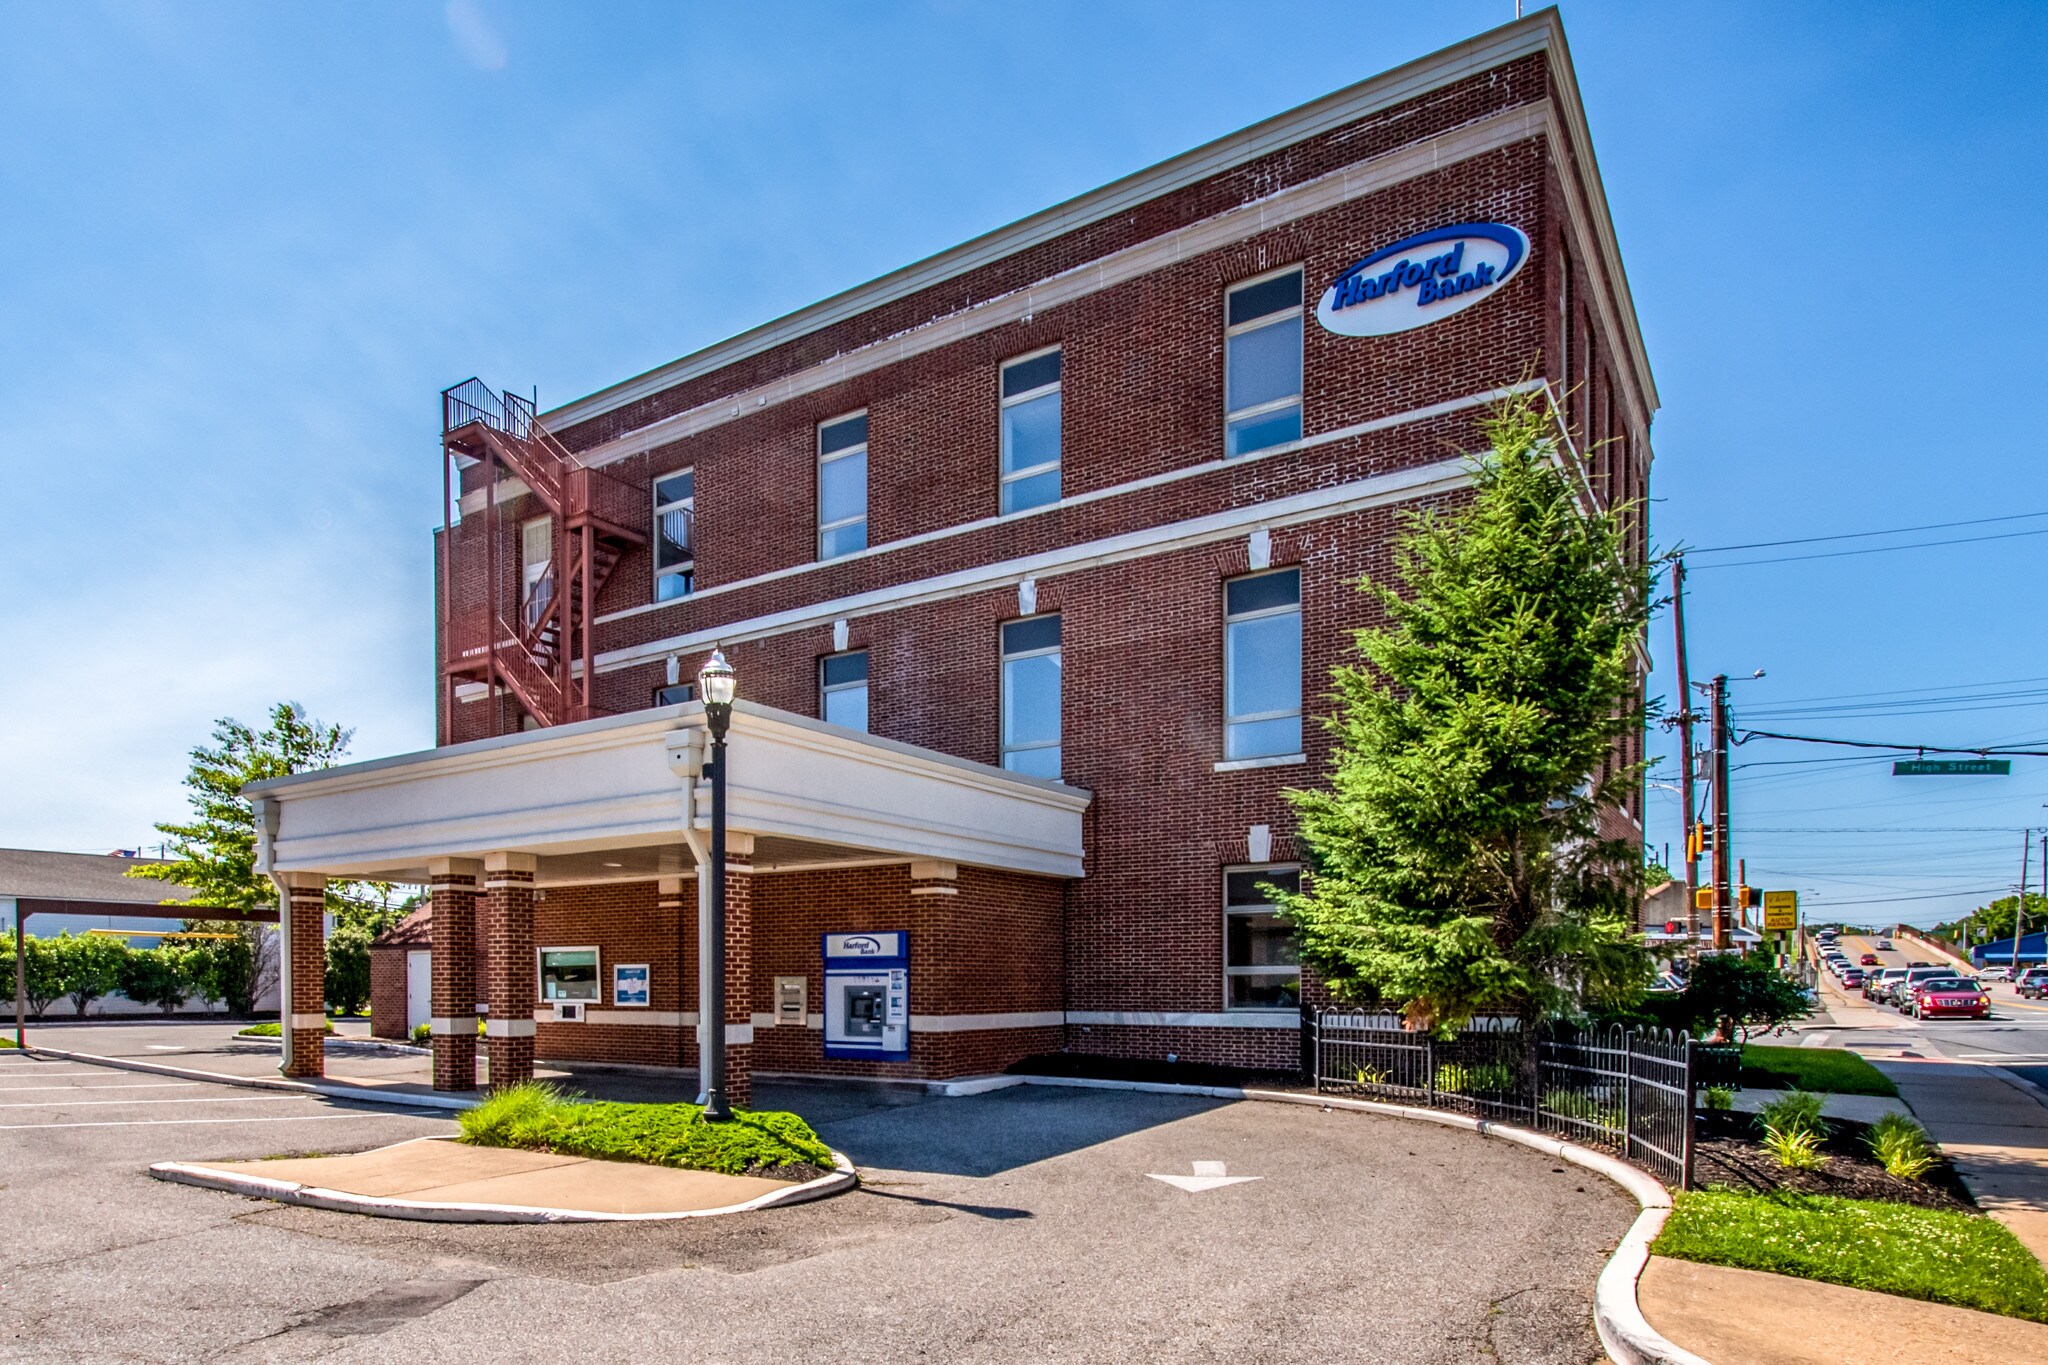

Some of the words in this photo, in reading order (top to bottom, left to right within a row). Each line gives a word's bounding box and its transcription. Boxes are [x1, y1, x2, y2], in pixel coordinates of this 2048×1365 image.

[1332, 241, 1465, 311] Harford
[1417, 261, 1495, 307] Bank
[1911, 763, 1940, 772] High
[1948, 763, 1992, 771] Street
[843, 941, 869, 949] Harford
